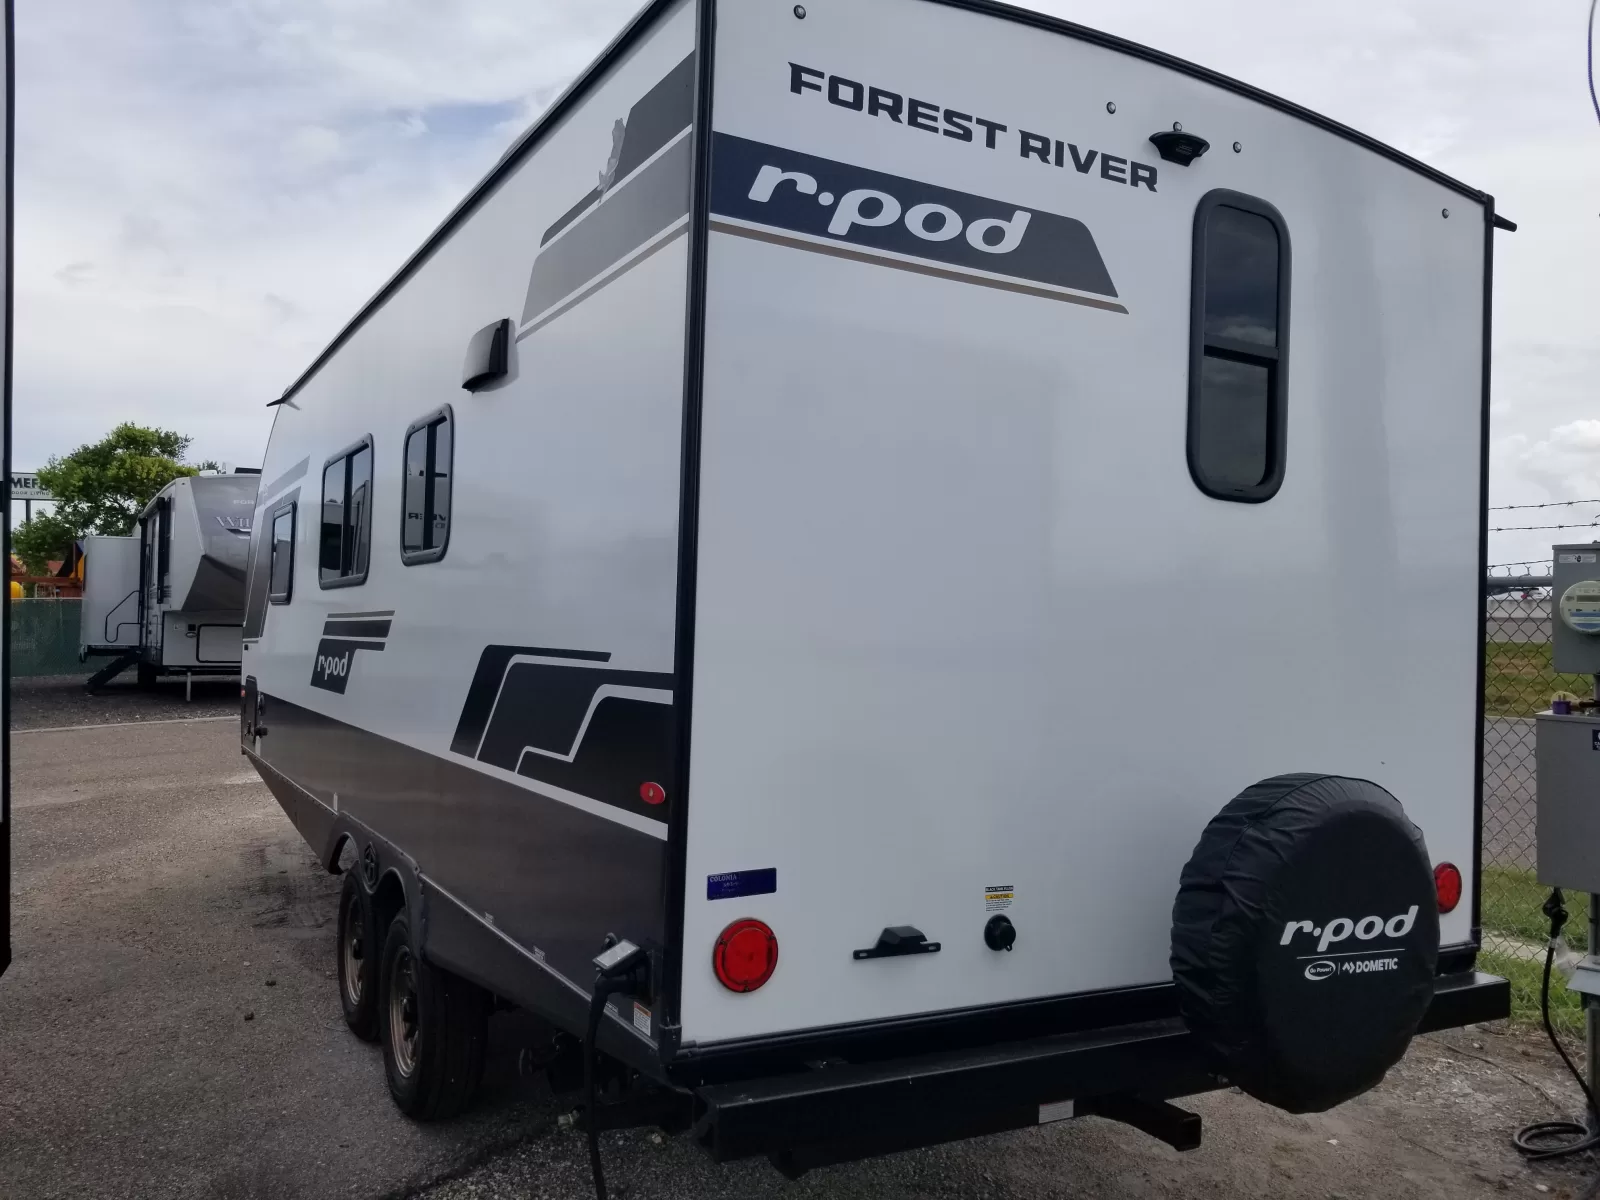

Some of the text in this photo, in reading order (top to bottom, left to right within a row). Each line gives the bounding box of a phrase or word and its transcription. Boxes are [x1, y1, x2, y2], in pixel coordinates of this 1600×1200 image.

[788, 61, 1158, 192] FOREST RIVER
[1355, 958, 1398, 973] DOMETIC
